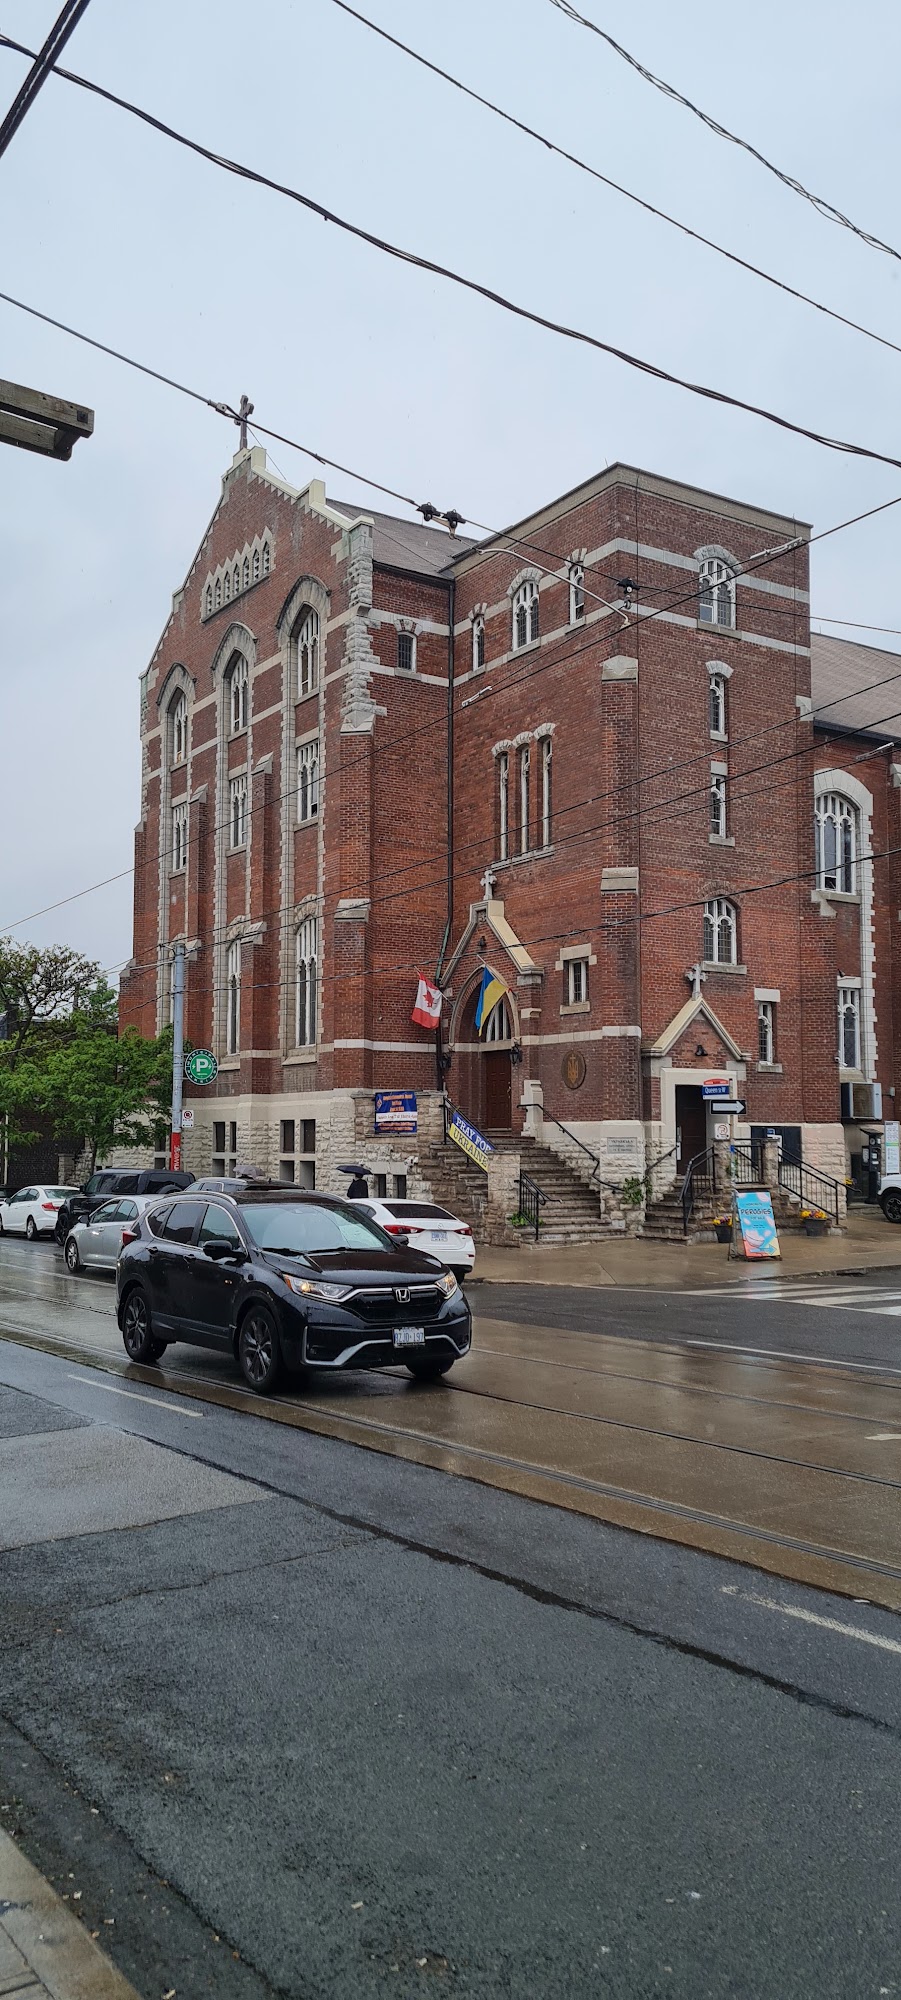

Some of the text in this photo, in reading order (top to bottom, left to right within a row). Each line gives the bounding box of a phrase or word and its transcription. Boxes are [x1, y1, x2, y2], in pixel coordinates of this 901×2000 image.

[196, 1059, 209, 1072] P
[455, 1116, 476, 1140] PRAY
[740, 1208, 772, 1216] PEROGIES
